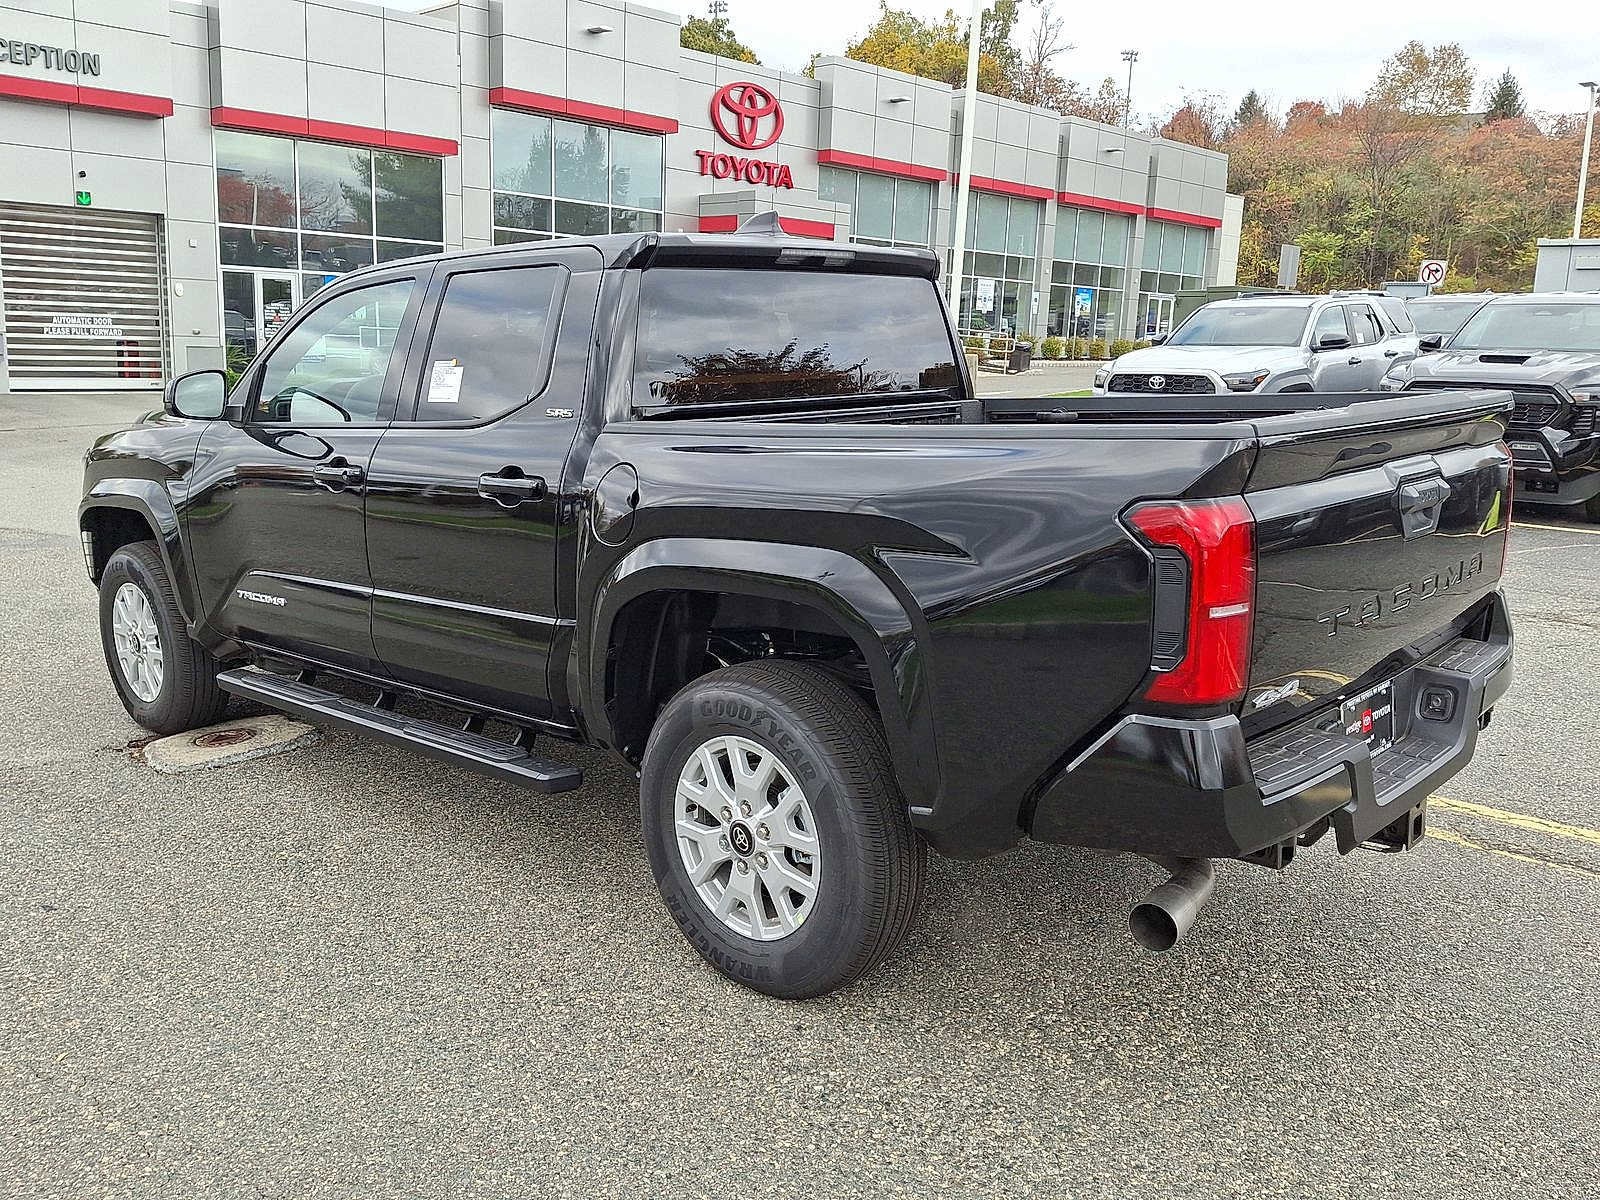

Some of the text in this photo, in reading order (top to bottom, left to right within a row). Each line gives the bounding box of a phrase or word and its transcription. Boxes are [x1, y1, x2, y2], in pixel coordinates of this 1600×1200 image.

[695, 149, 794, 189] TOYOTA
[52, 315, 113, 325] AUTOMATIC DOOR
[43, 327, 123, 336] PLEASE PULL FORWARD
[236, 589, 288, 607] TACOMA
[1317, 552, 1483, 637] TACOMA
[1372, 704, 1391, 721] TOYOTA
